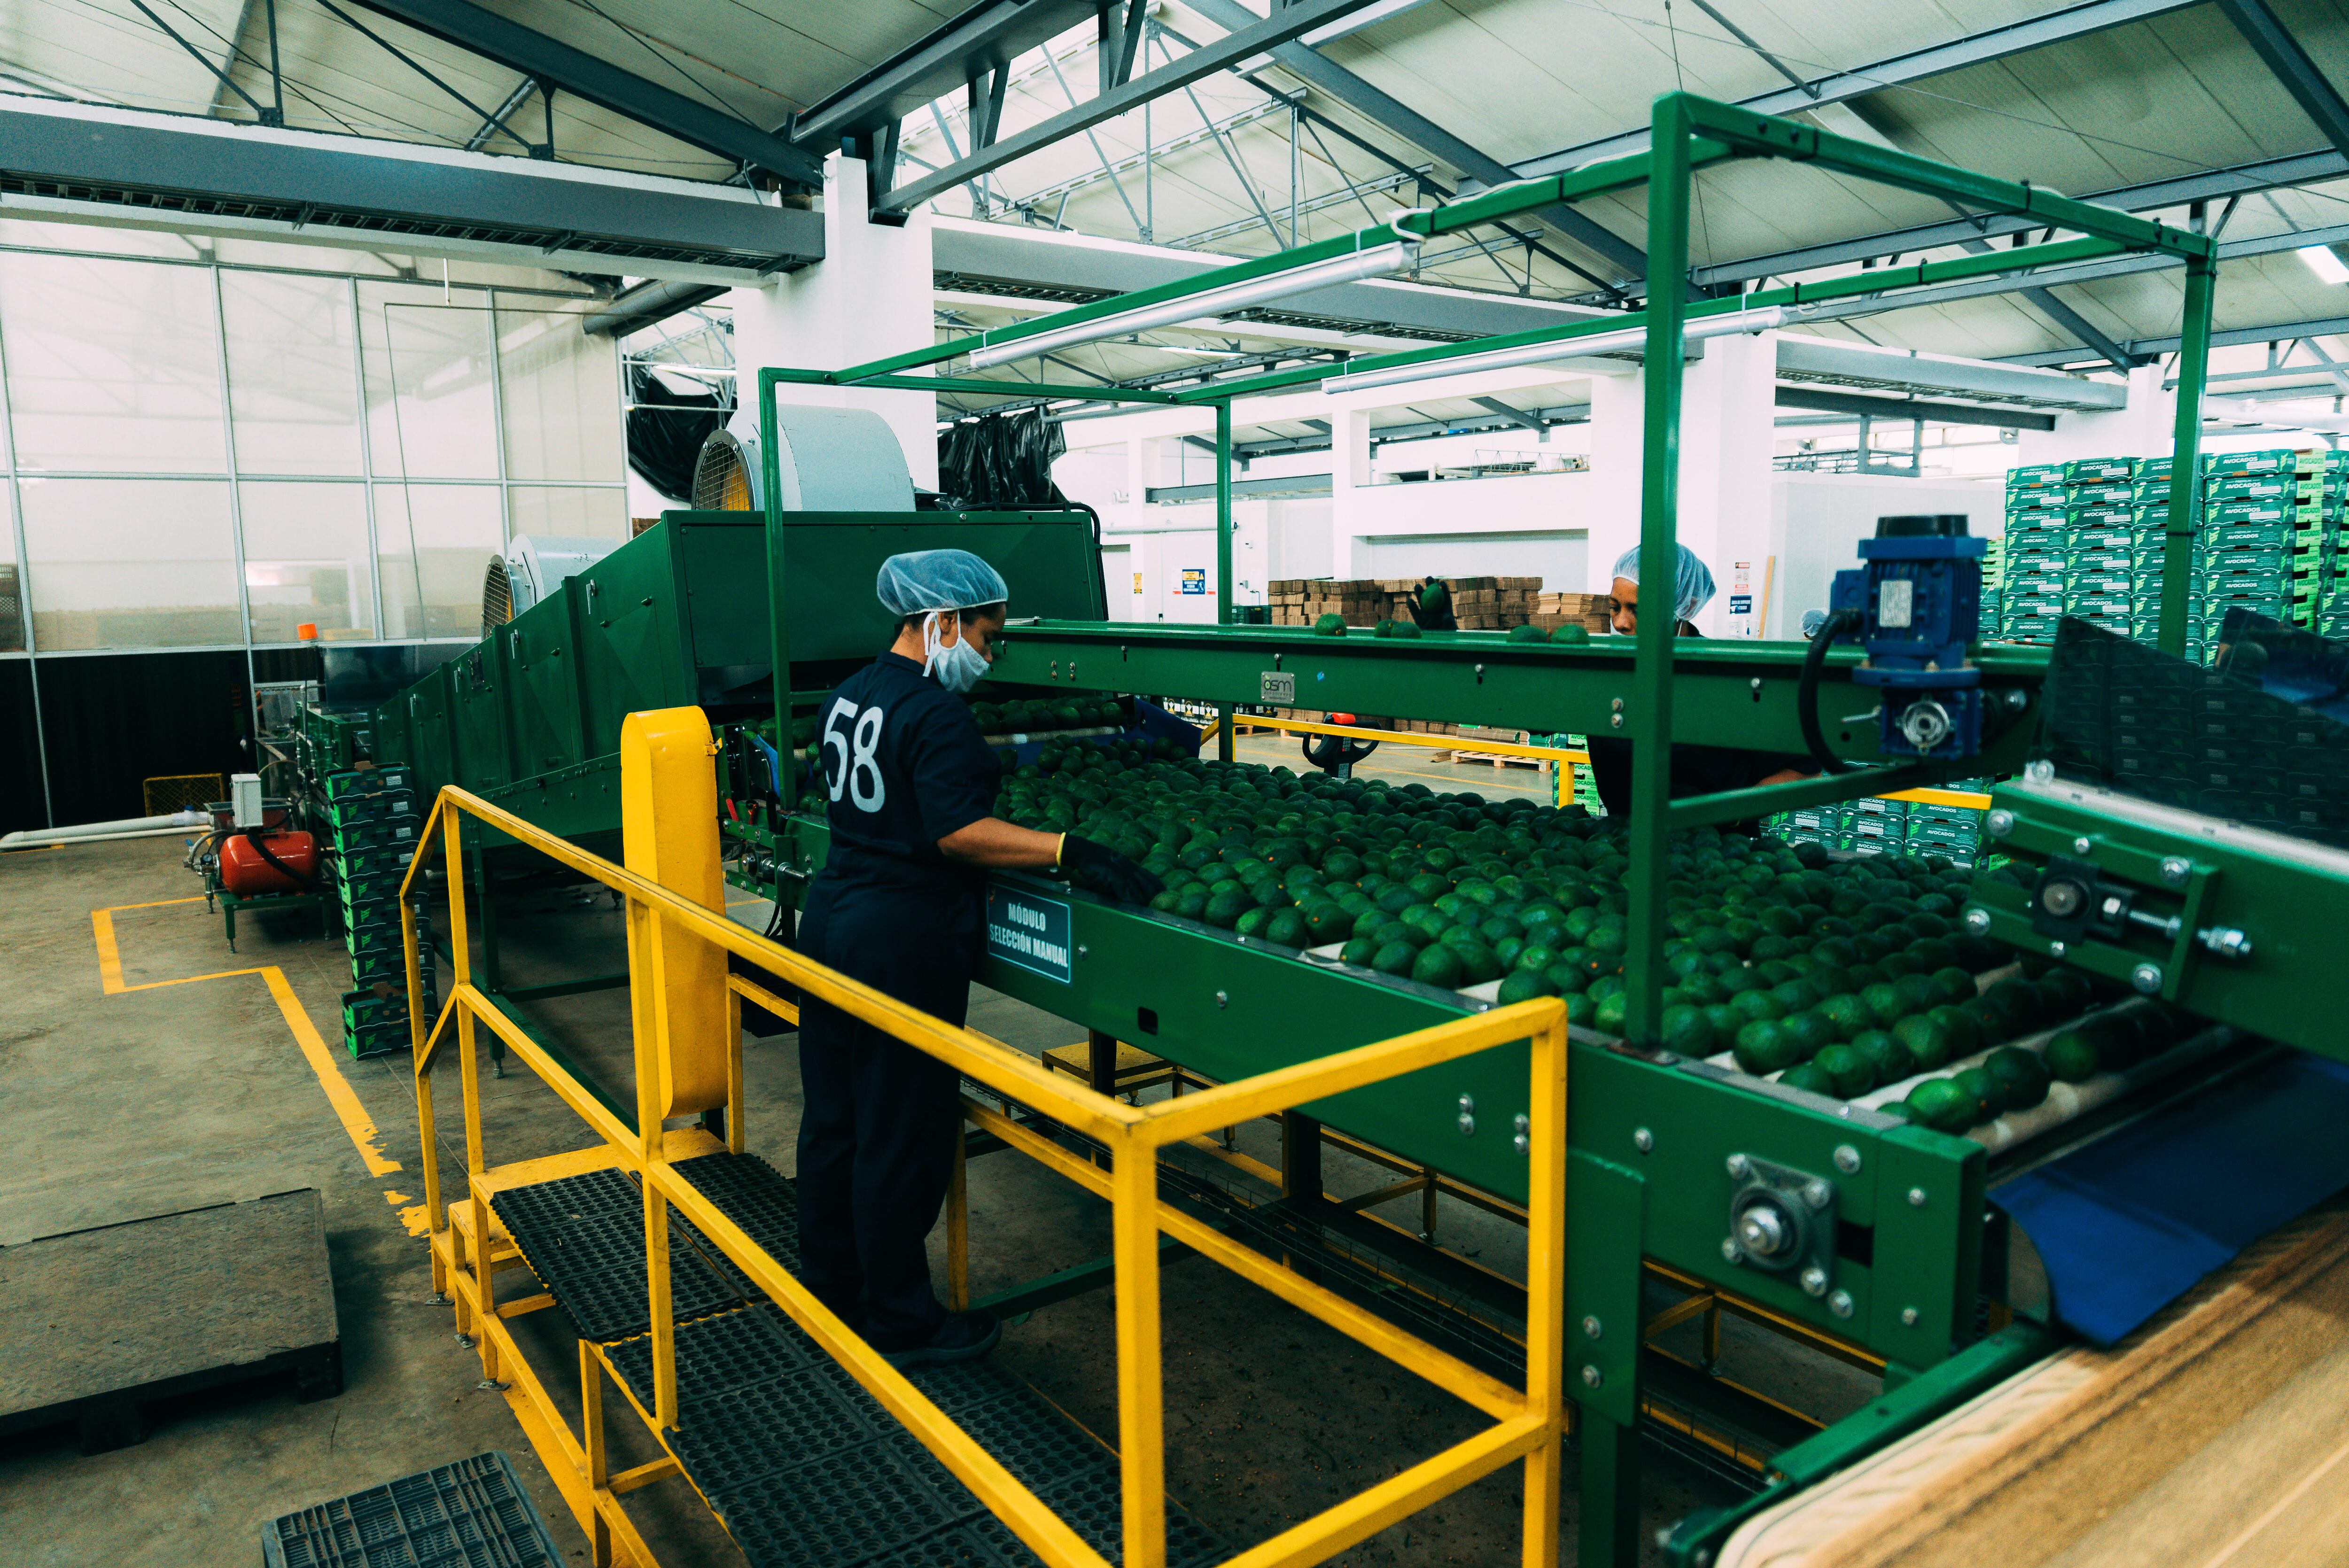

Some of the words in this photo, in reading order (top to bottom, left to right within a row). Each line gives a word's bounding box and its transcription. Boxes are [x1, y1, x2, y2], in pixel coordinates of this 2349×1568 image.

[824, 697, 885, 813] 58
[1008, 902, 1046, 931] MÓDULO
[989, 923, 1032, 955] SELECCIÓN
[1033, 938, 1068, 968] MANUAL
